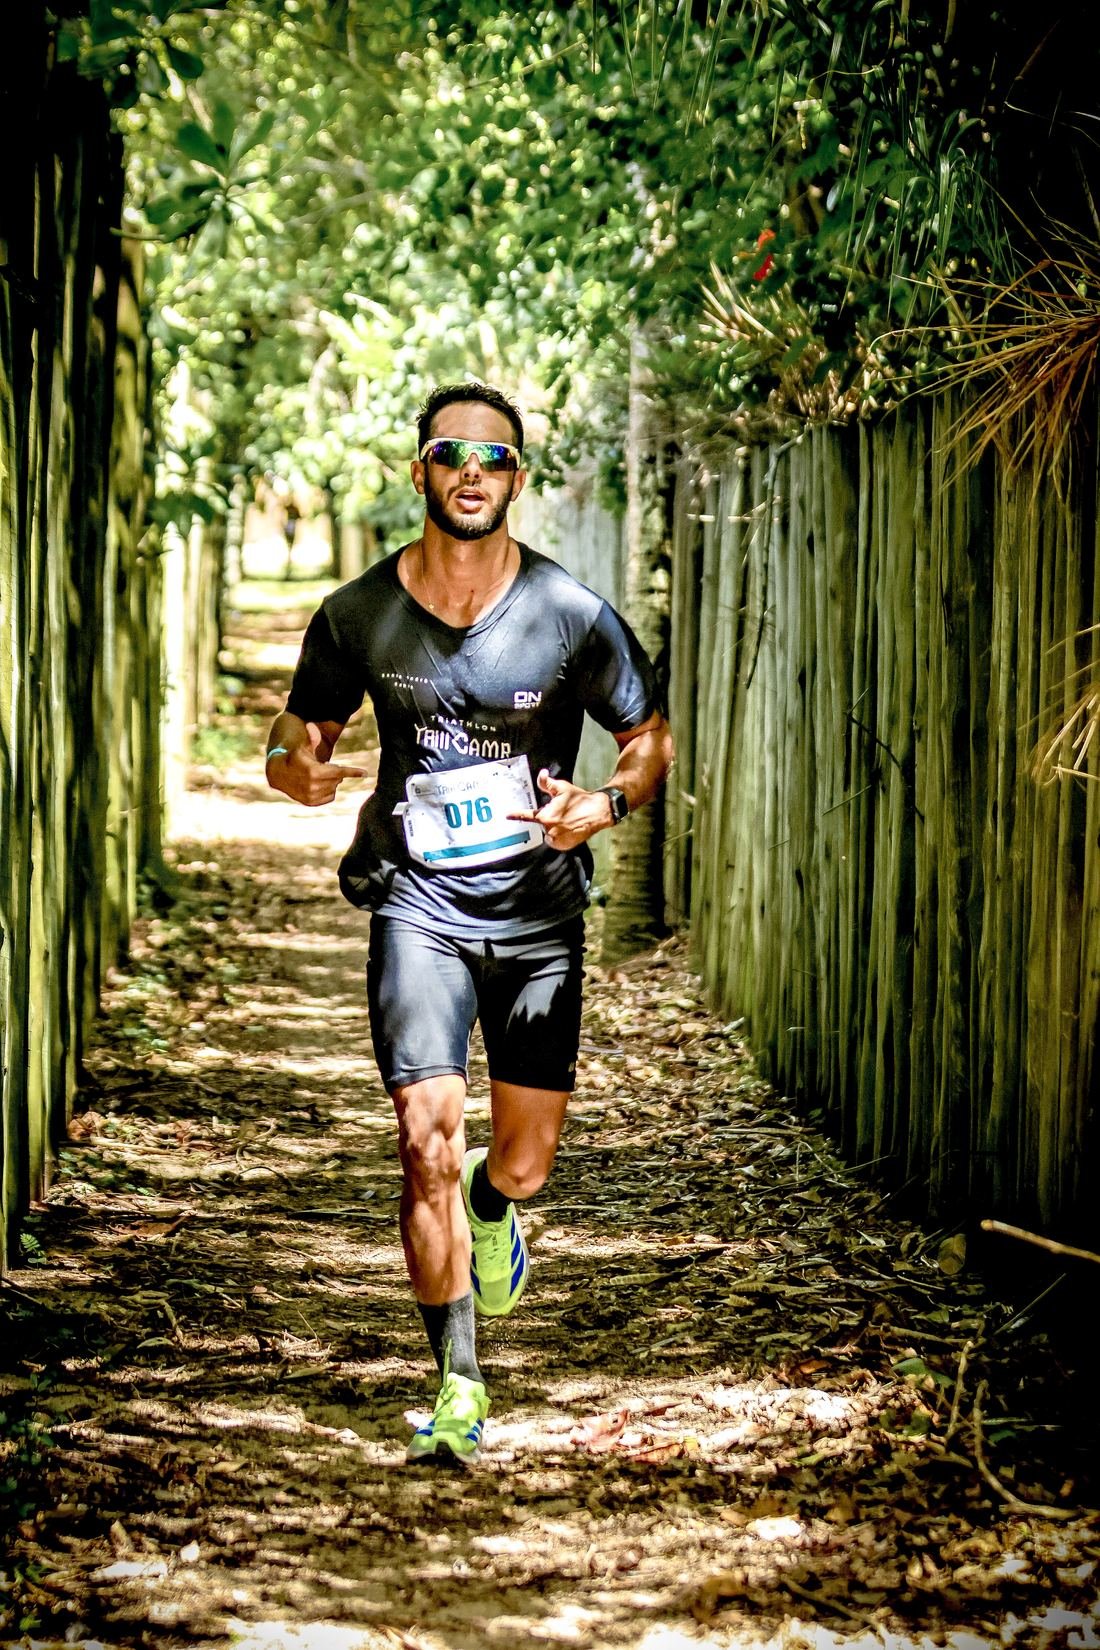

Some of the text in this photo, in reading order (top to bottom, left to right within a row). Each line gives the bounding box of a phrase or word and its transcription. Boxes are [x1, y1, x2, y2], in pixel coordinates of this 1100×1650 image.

[514, 691, 542, 702] ON
[430, 715, 497, 732] TRIATHLON
[445, 796, 493, 829] 076
